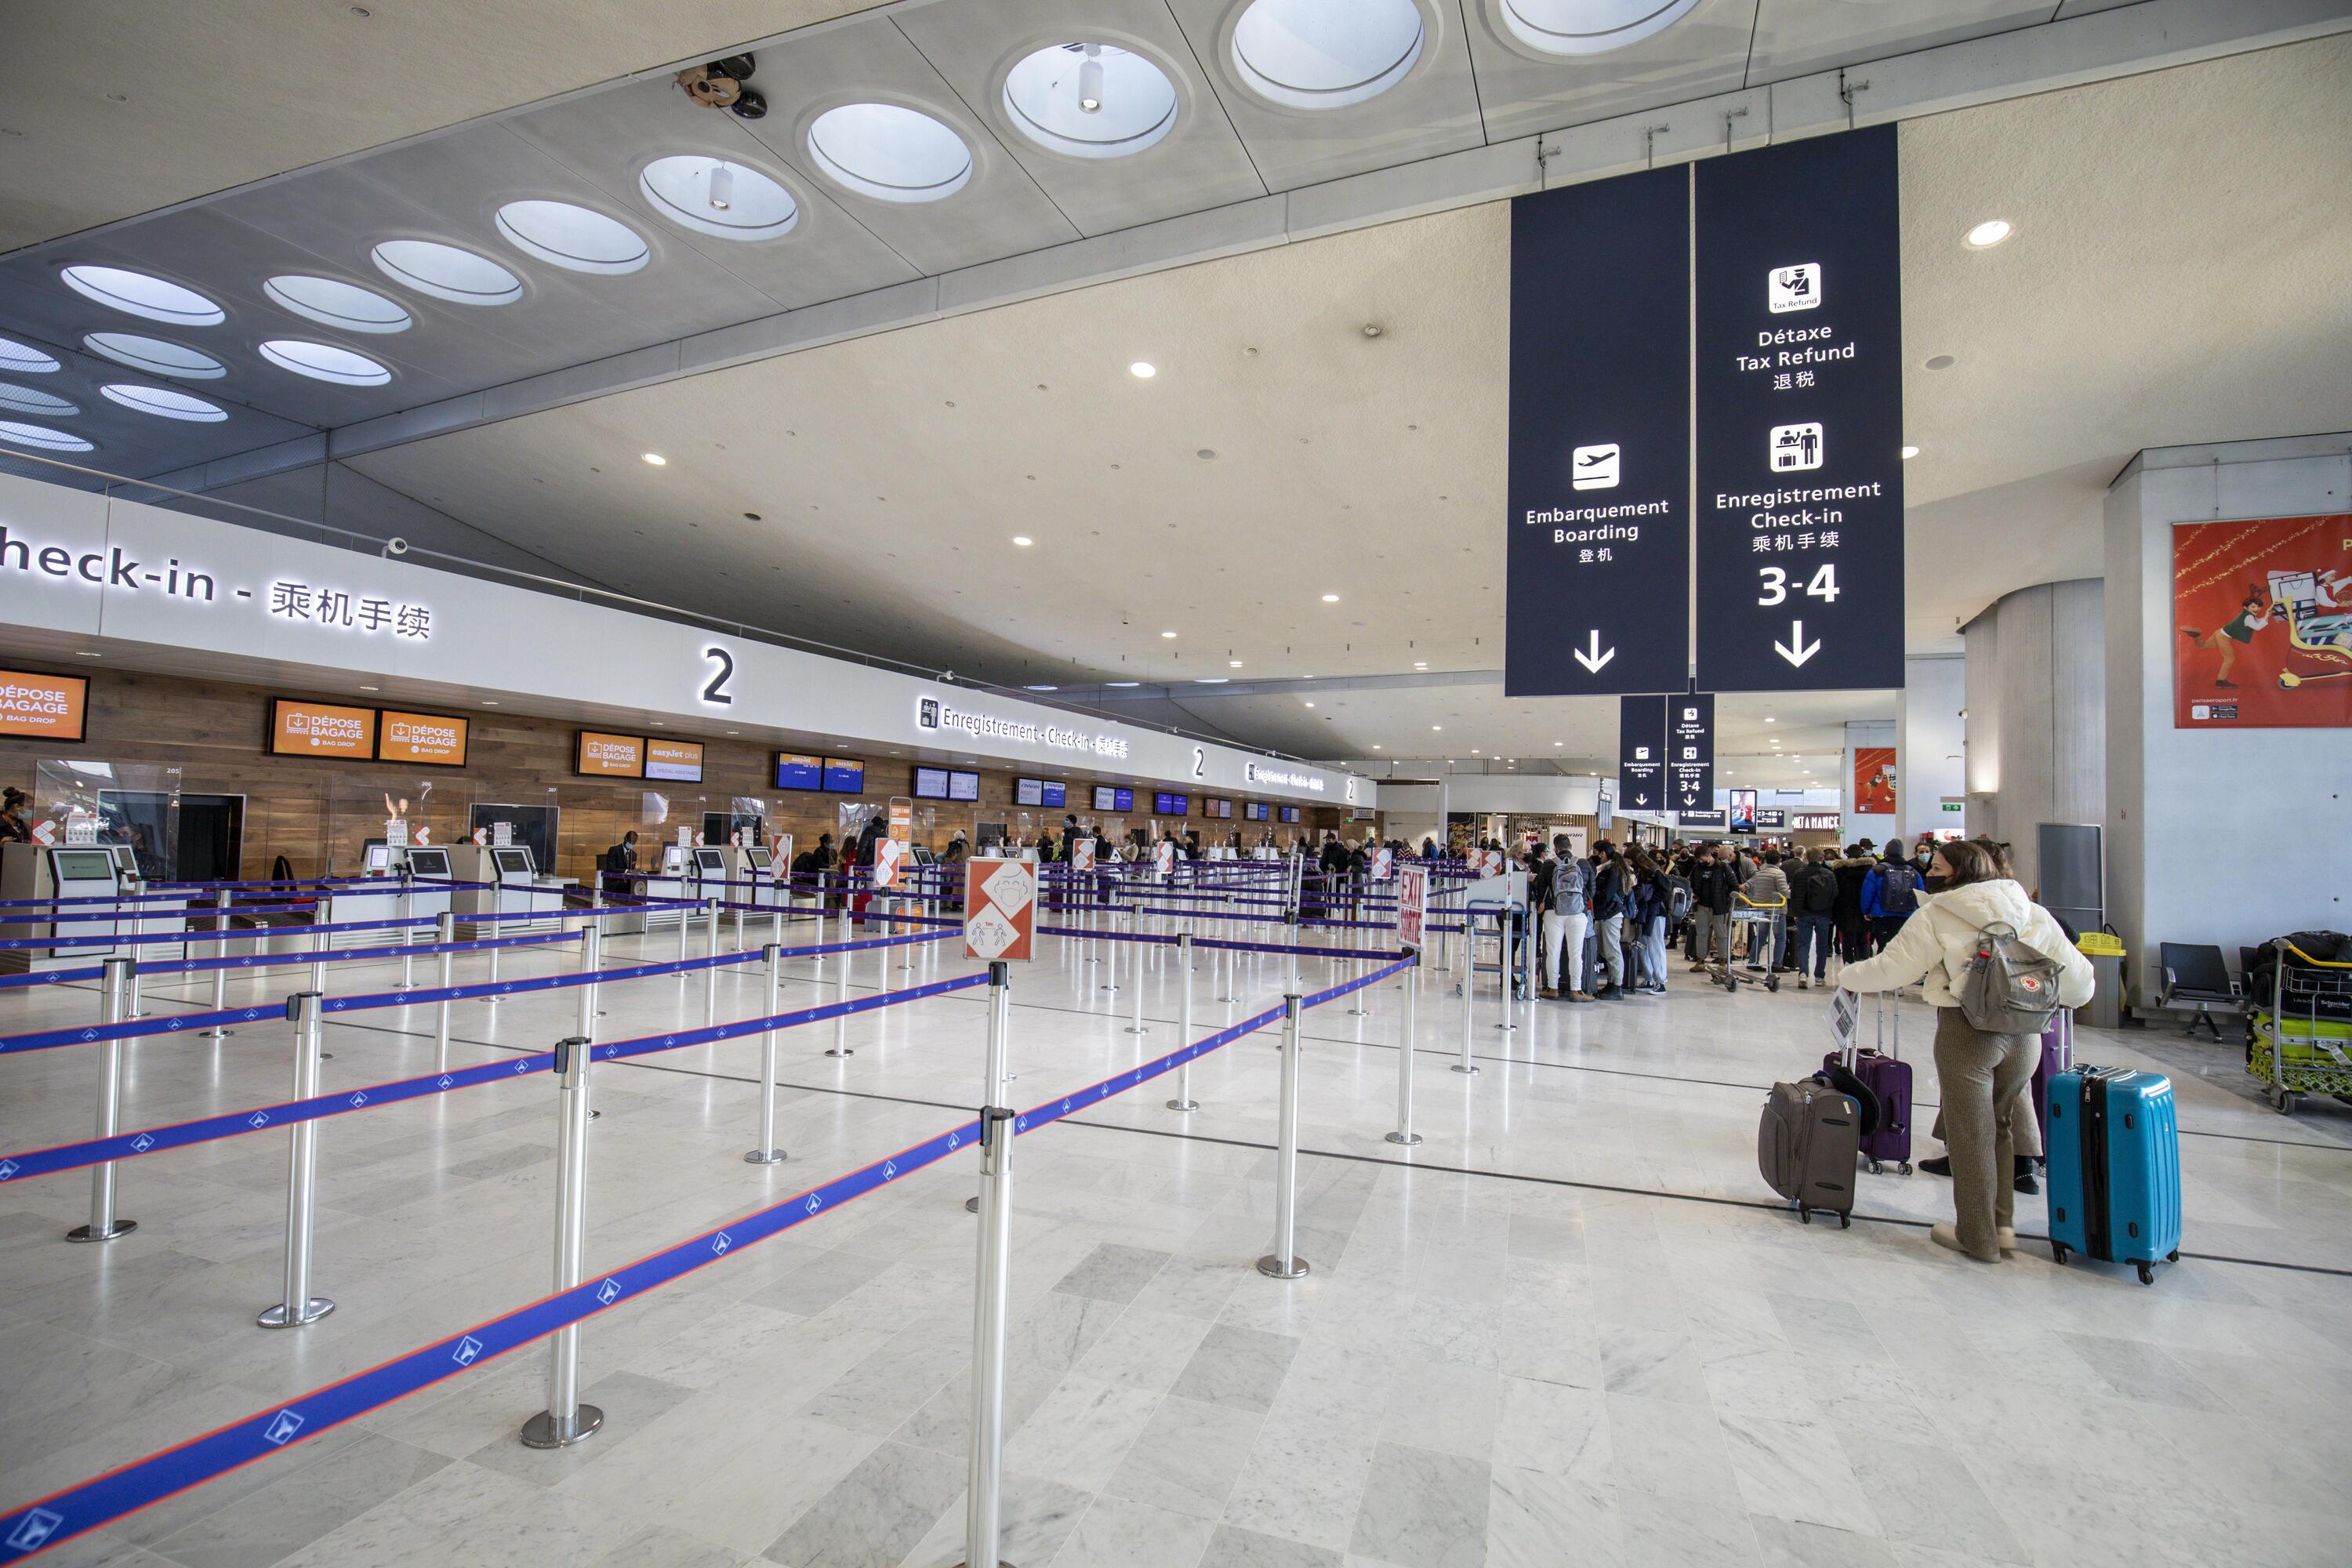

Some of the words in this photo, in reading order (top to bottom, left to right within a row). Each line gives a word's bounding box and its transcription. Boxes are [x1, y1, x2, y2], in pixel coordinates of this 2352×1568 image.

[1788, 297, 1817, 307] Refund
[1759, 326, 1832, 347] Détaxe
[1737, 356, 1771, 372] Tax
[1779, 343, 1855, 366] Refund
[1773, 370, 1815, 390] 退税
[1716, 481, 1881, 510] Enregistrement
[1526, 499, 1669, 526] Embarquement
[1751, 508, 1842, 529] Check-in
[1554, 524, 1639, 543] Boarding
[1752, 532, 1839, 553] 乘机手续
[1579, 547, 1613, 563] 登机
[1759, 564, 1840, 606] 3-4
[271, 582, 430, 640] 乘机手续
[703, 648, 734, 705] 2
[0, 699, 68, 714] AGAGE
[311, 715, 361, 729] DÉPOSE
[412, 724, 456, 737] DÉPOSE
[944, 708, 1037, 741] Enregistrement
[1048, 728, 1090, 750] Check-in
[311, 726, 363, 739] BAGAGE
[412, 735, 457, 746] BAGAGE
[603, 743, 635, 753] DÉPOSE
[603, 752, 637, 762] BAGAGE
[652, 749, 683, 758] easyJet
[1196, 749, 1204, 777] 2
[1680, 781, 1700, 791] 3-4
[1401, 869, 1424, 908] EXIT
[1399, 908, 1421, 945] SORTIE
